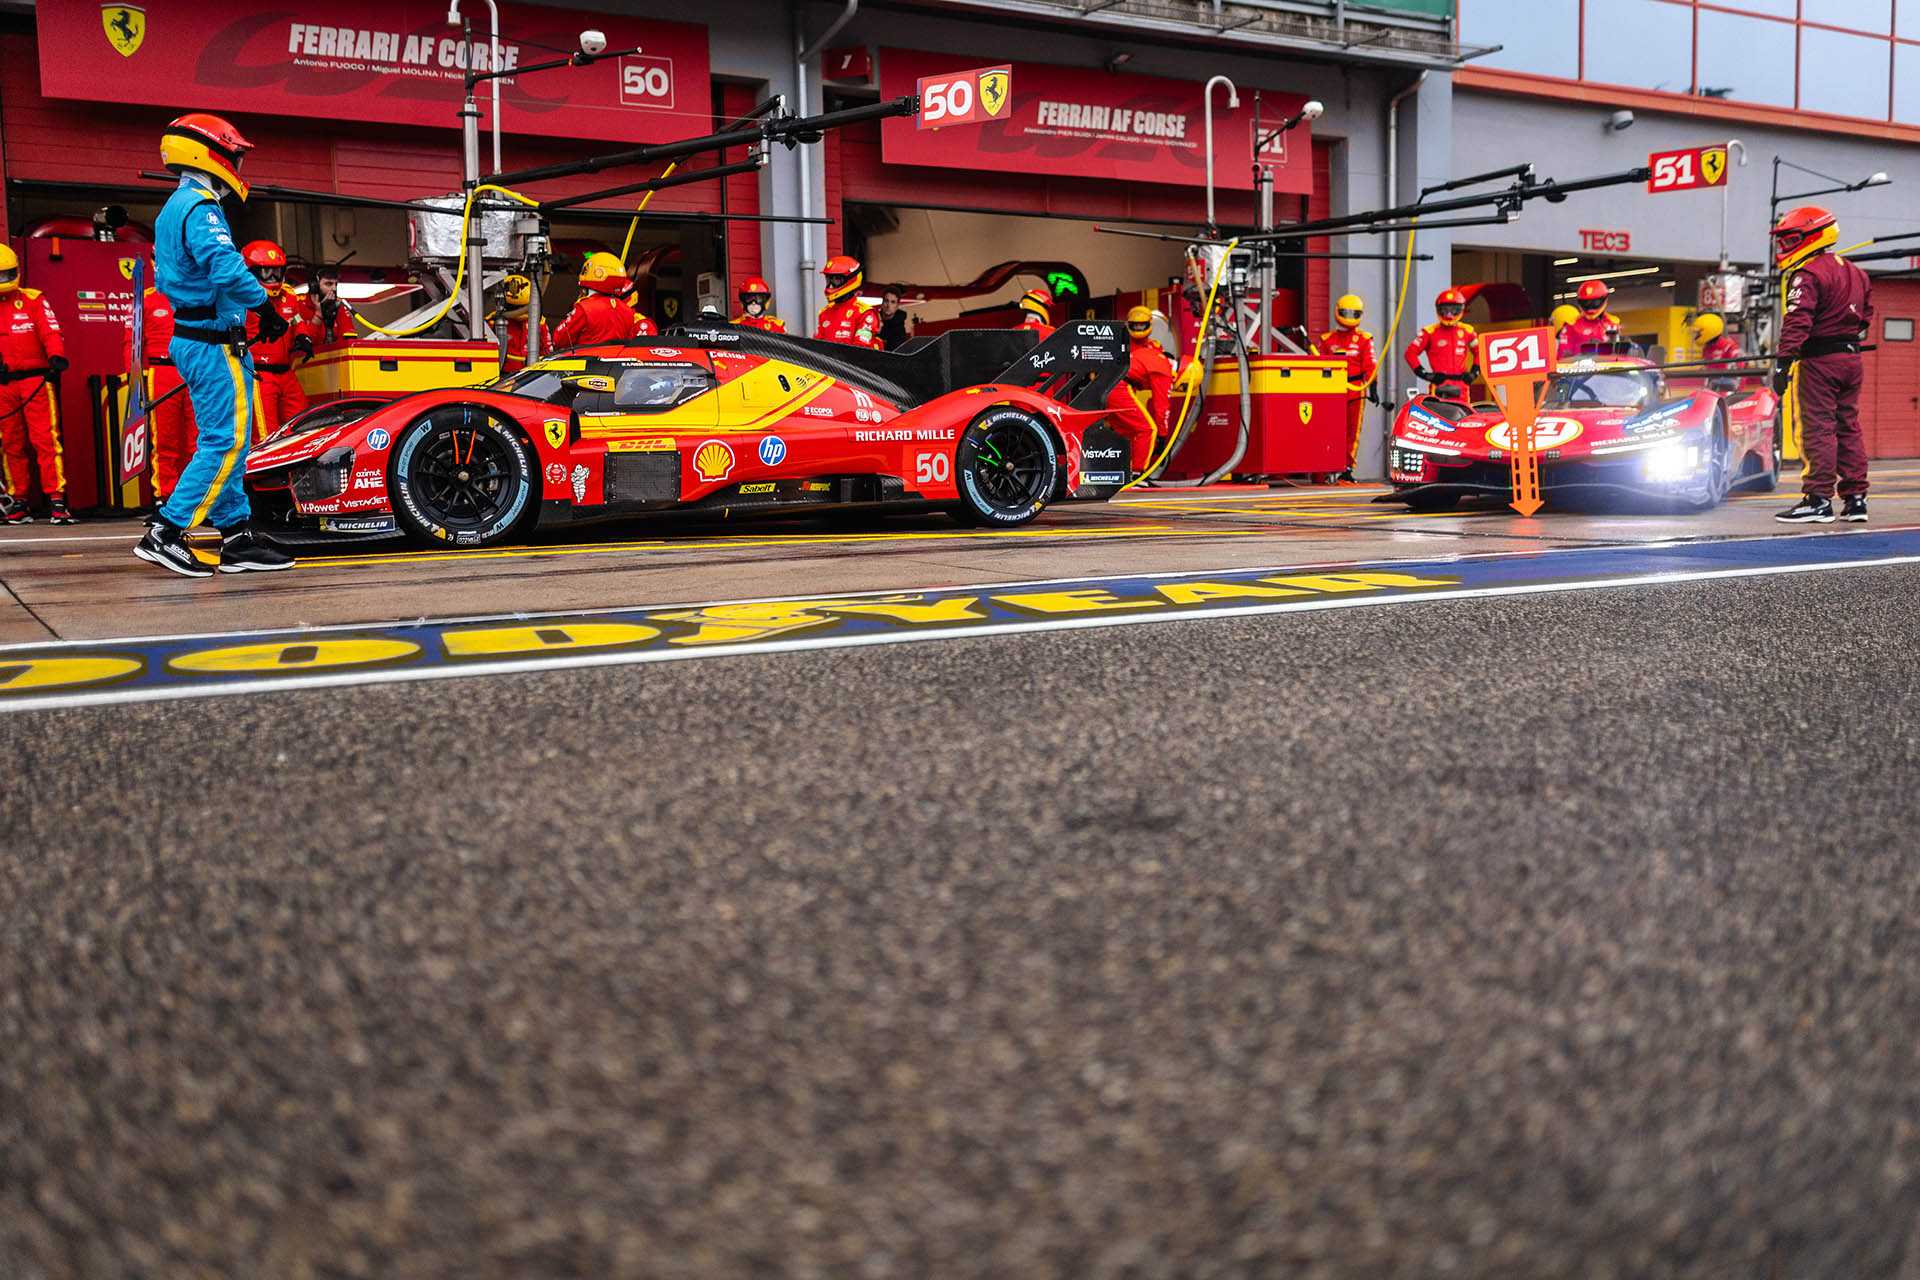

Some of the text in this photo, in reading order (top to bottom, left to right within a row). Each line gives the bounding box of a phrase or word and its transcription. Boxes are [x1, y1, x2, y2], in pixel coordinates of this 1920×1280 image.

[288, 23, 519, 72] FERRARI AF CORSE
[293, 58, 328, 68] Antonio
[330, 61, 366, 71] FUOCO
[372, 65, 400, 75] Miguel
[402, 68, 438, 77] MOLINA
[624, 65, 669, 97] 50
[924, 80, 973, 121] 50
[1037, 101, 1186, 138] FERRARI AF CORSE
[1257, 128, 1283, 154] 51
[1654, 154, 1695, 188] 51
[1579, 229, 1630, 251] TEC3
[717, 334, 740, 342] GROUP
[1488, 335, 1546, 373] 51
[992, 411, 1028, 422] MICHELIN
[370, 429, 388, 450] hp
[618, 439, 667, 449] DHL
[855, 429, 955, 441] RICHARD MILLE
[124, 423, 145, 472] 50
[502, 430, 529, 477] MICHELIN
[762, 436, 782, 465] hp
[355, 468, 381, 477] azimut
[916, 452, 949, 483] 50
[743, 483, 772, 493] Sabelt
[300, 502, 340, 513] V-Power
[399, 481, 431, 528] MICHELIN
[994, 508, 1031, 520] MICHELIN
[338, 521, 388, 529] MICHELIN
